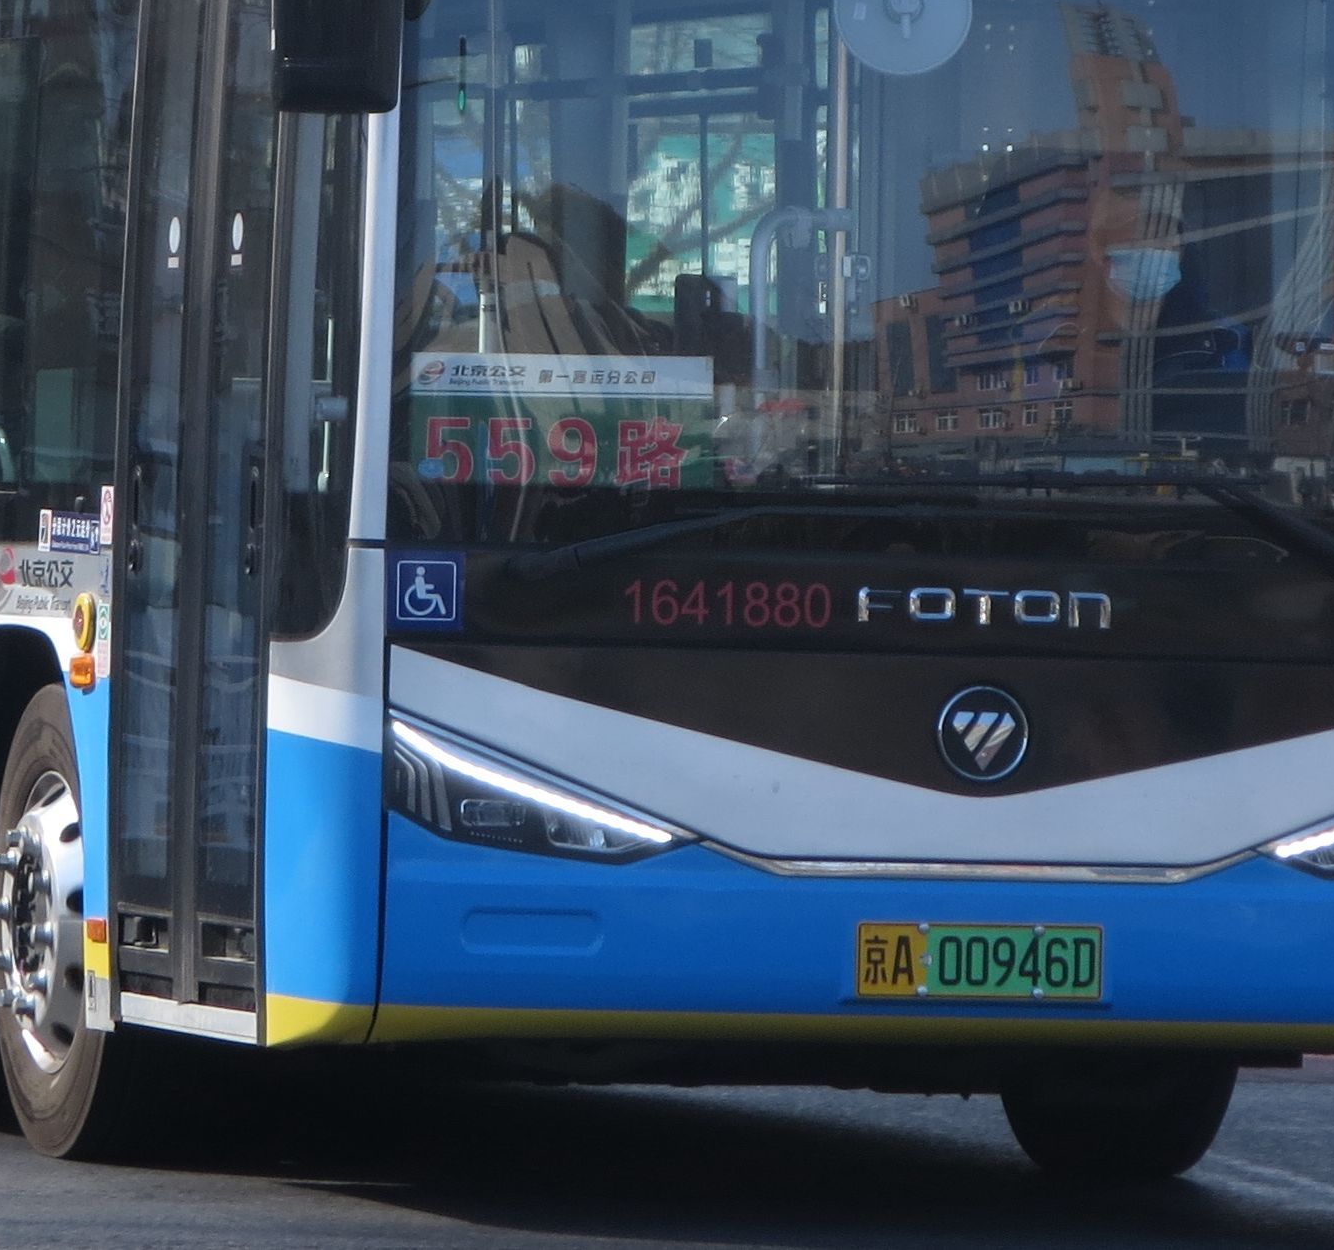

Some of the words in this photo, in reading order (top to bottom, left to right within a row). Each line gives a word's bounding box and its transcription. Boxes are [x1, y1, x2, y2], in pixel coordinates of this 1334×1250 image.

[451, 364, 526, 377] 北京公交
[538, 369, 656, 384] 第一客运分公司
[425, 416, 688, 488] 559路
[18, 559, 74, 588] 北京公交
[624, 579, 832, 628] 1641880
[857, 586, 1112, 629] FOTON
[863, 935, 915, 986] 京A
[938, 936, 1096, 989] 00946D
